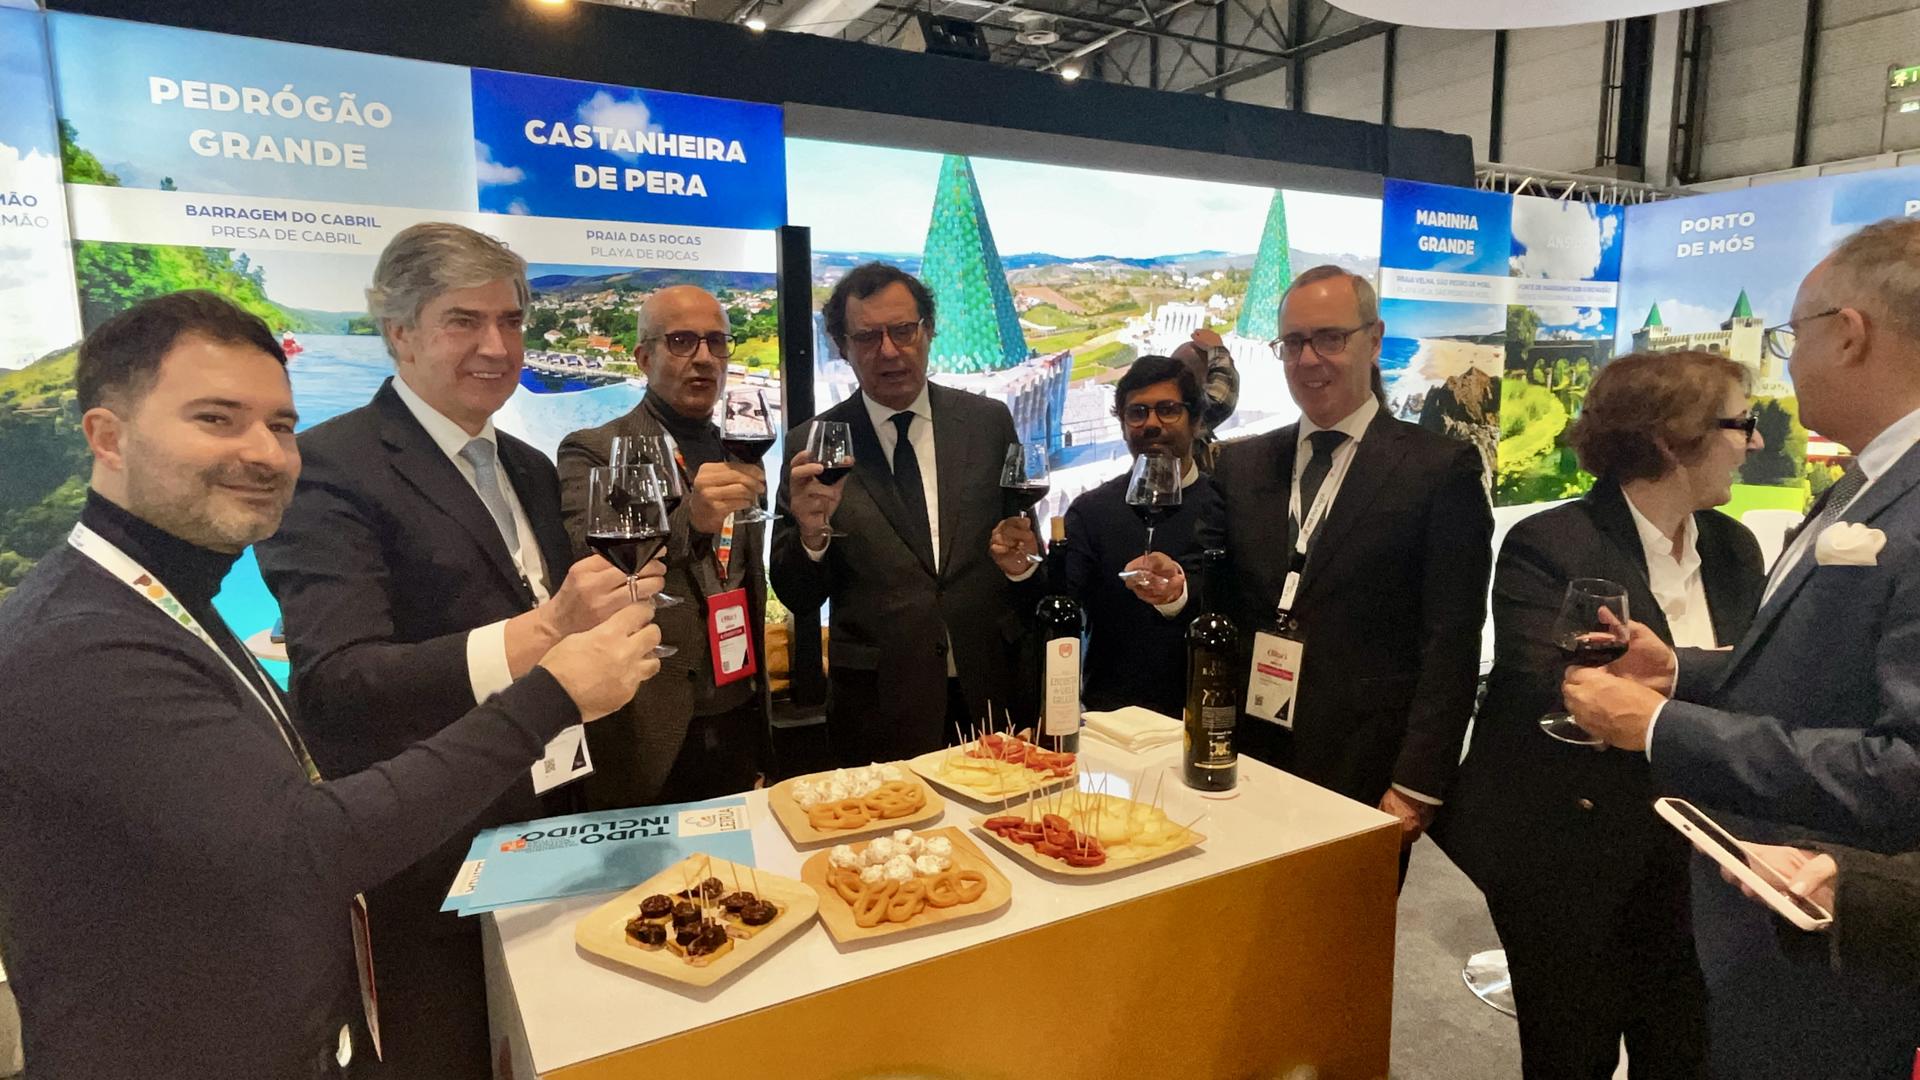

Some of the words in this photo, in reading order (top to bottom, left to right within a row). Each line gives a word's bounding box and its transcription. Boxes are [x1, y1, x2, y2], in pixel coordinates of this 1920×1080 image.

[148, 76, 392, 129] PEDRÓGÃO
[188, 129, 368, 170] GRANDE
[524, 119, 746, 163] CASTANHEIRA
[575, 164, 618, 191] DE
[625, 168, 707, 197] PERA
[185, 204, 288, 222] BARRAGEM
[292, 212, 316, 224] DO
[321, 213, 381, 228] CABRIL
[1416, 209, 1479, 231] MARINHA
[1680, 211, 1756, 234] PORTO
[211, 225, 270, 239] PRESA
[275, 229, 298, 241] DE
[302, 230, 362, 245] CABRIL
[586, 230, 627, 242] PRAIA
[630, 232, 656, 243] DAS
[659, 234, 702, 246] ROCAS
[1418, 236, 1475, 256] GRANDE
[1677, 241, 1704, 258] DE
[1708, 234, 1755, 255] MÓS
[591, 246, 633, 258] PLAYA
[637, 248, 653, 259] DE
[657, 250, 699, 261] ROCAS
[580, 827, 670, 844] TUDO
